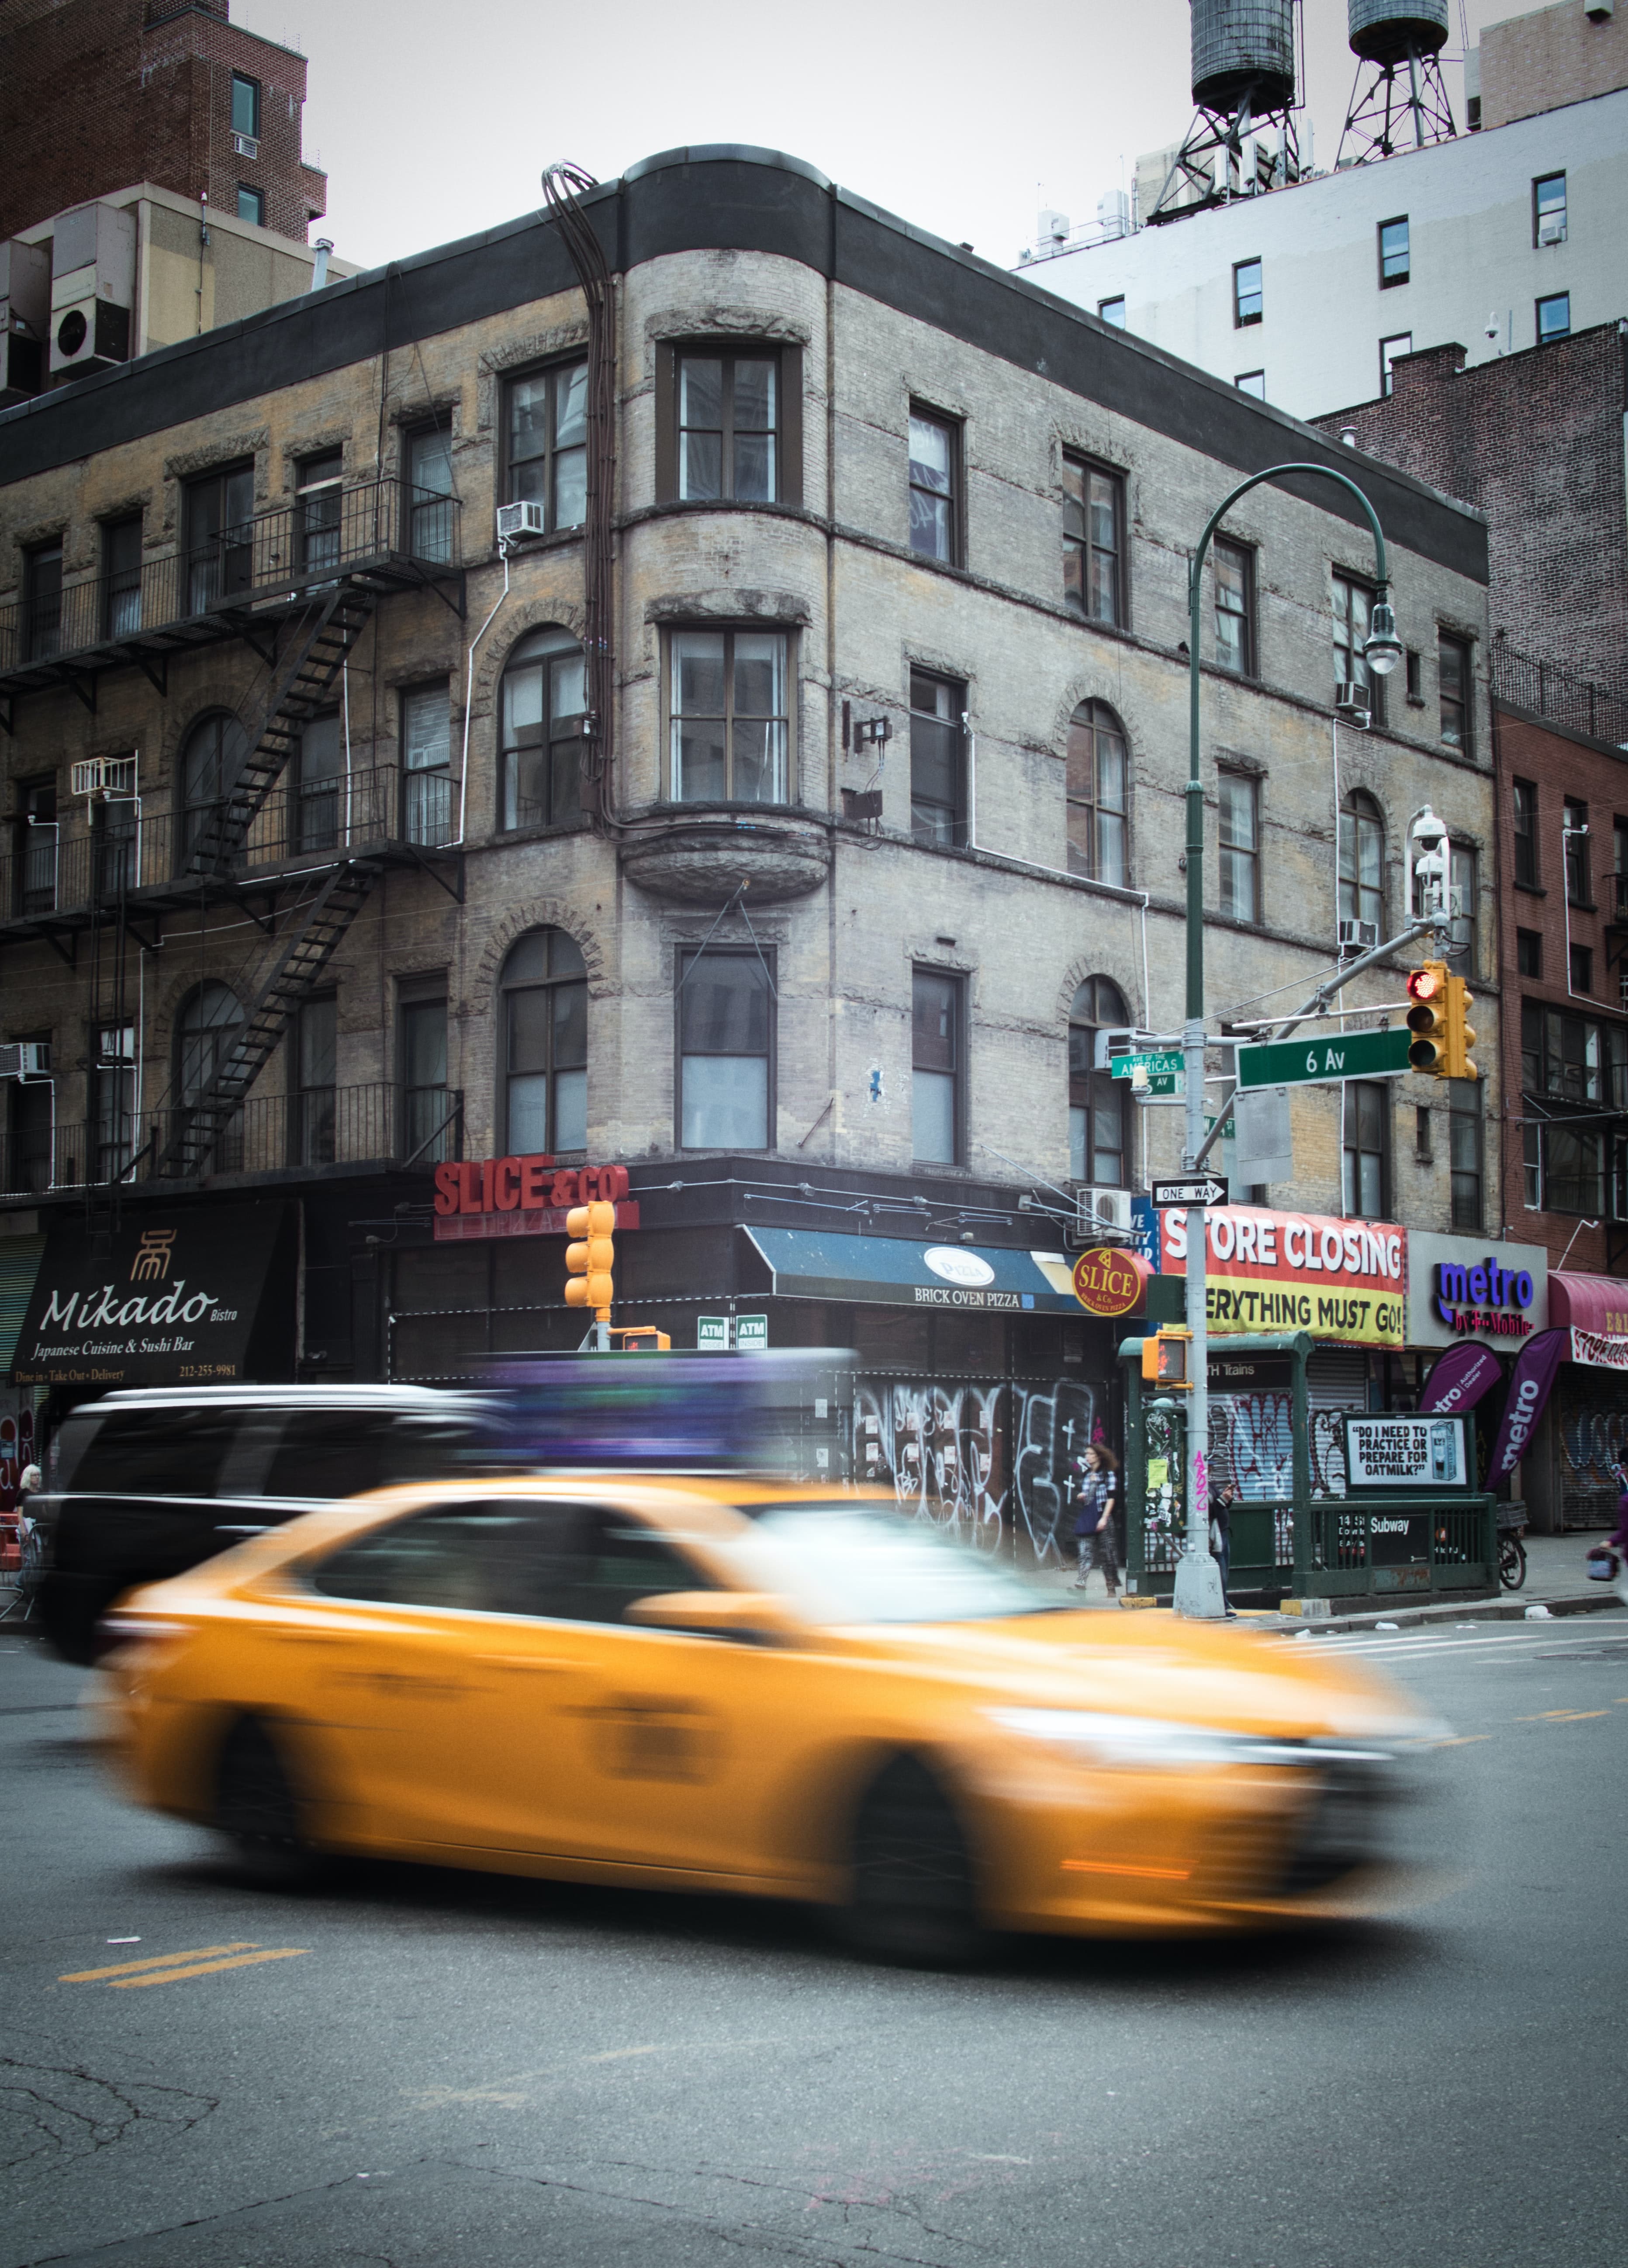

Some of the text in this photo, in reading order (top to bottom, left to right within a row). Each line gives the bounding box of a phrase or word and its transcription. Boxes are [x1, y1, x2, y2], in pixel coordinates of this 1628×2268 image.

[1306, 1048, 1345, 1073] 6 Av
[1157, 1077, 1168, 1086] AV
[434, 1155, 552, 1215] SLICE
[1163, 1187, 1217, 1199] ONE WAY
[1284, 1221, 1401, 1279] CLOSING
[1079, 1264, 1133, 1297] SLICE
[1440, 1257, 1534, 1309] metro
[40, 1280, 237, 1331] Mikado Bistro
[914, 1288, 1020, 1308] BRICK OVEN PIZZA
[1206, 1288, 1401, 1334] ERYTHING MUST GO!
[701, 1324, 723, 1337] ATM
[739, 1322, 764, 1336] ATM
[1455, 1309, 1469, 1333] by
[31, 1336, 195, 1361] Japanese Cuisine & Sushi Bar
[15, 1369, 125, 1382] Dine in Take Out Delivery
[179, 1364, 236, 1377] 212-255-9981
[1222, 1363, 1255, 1376] Trains
[1460, 1354, 1487, 1385] Authorized
[1465, 1370, 1482, 1389] Dealer
[1376, 1426, 1379, 1438] I
[1382, 1426, 1410, 1438] NEED
[1412, 1426, 1427, 1438] TO
[1501, 1380, 1539, 1471] metro
[1359, 1439, 1427, 1450] PRACTICE OR
[1359, 1451, 1428, 1463] PREPARE FOR
[1338, 1515, 1350, 1525] 14
[1371, 1517, 1409, 1535] Subway
